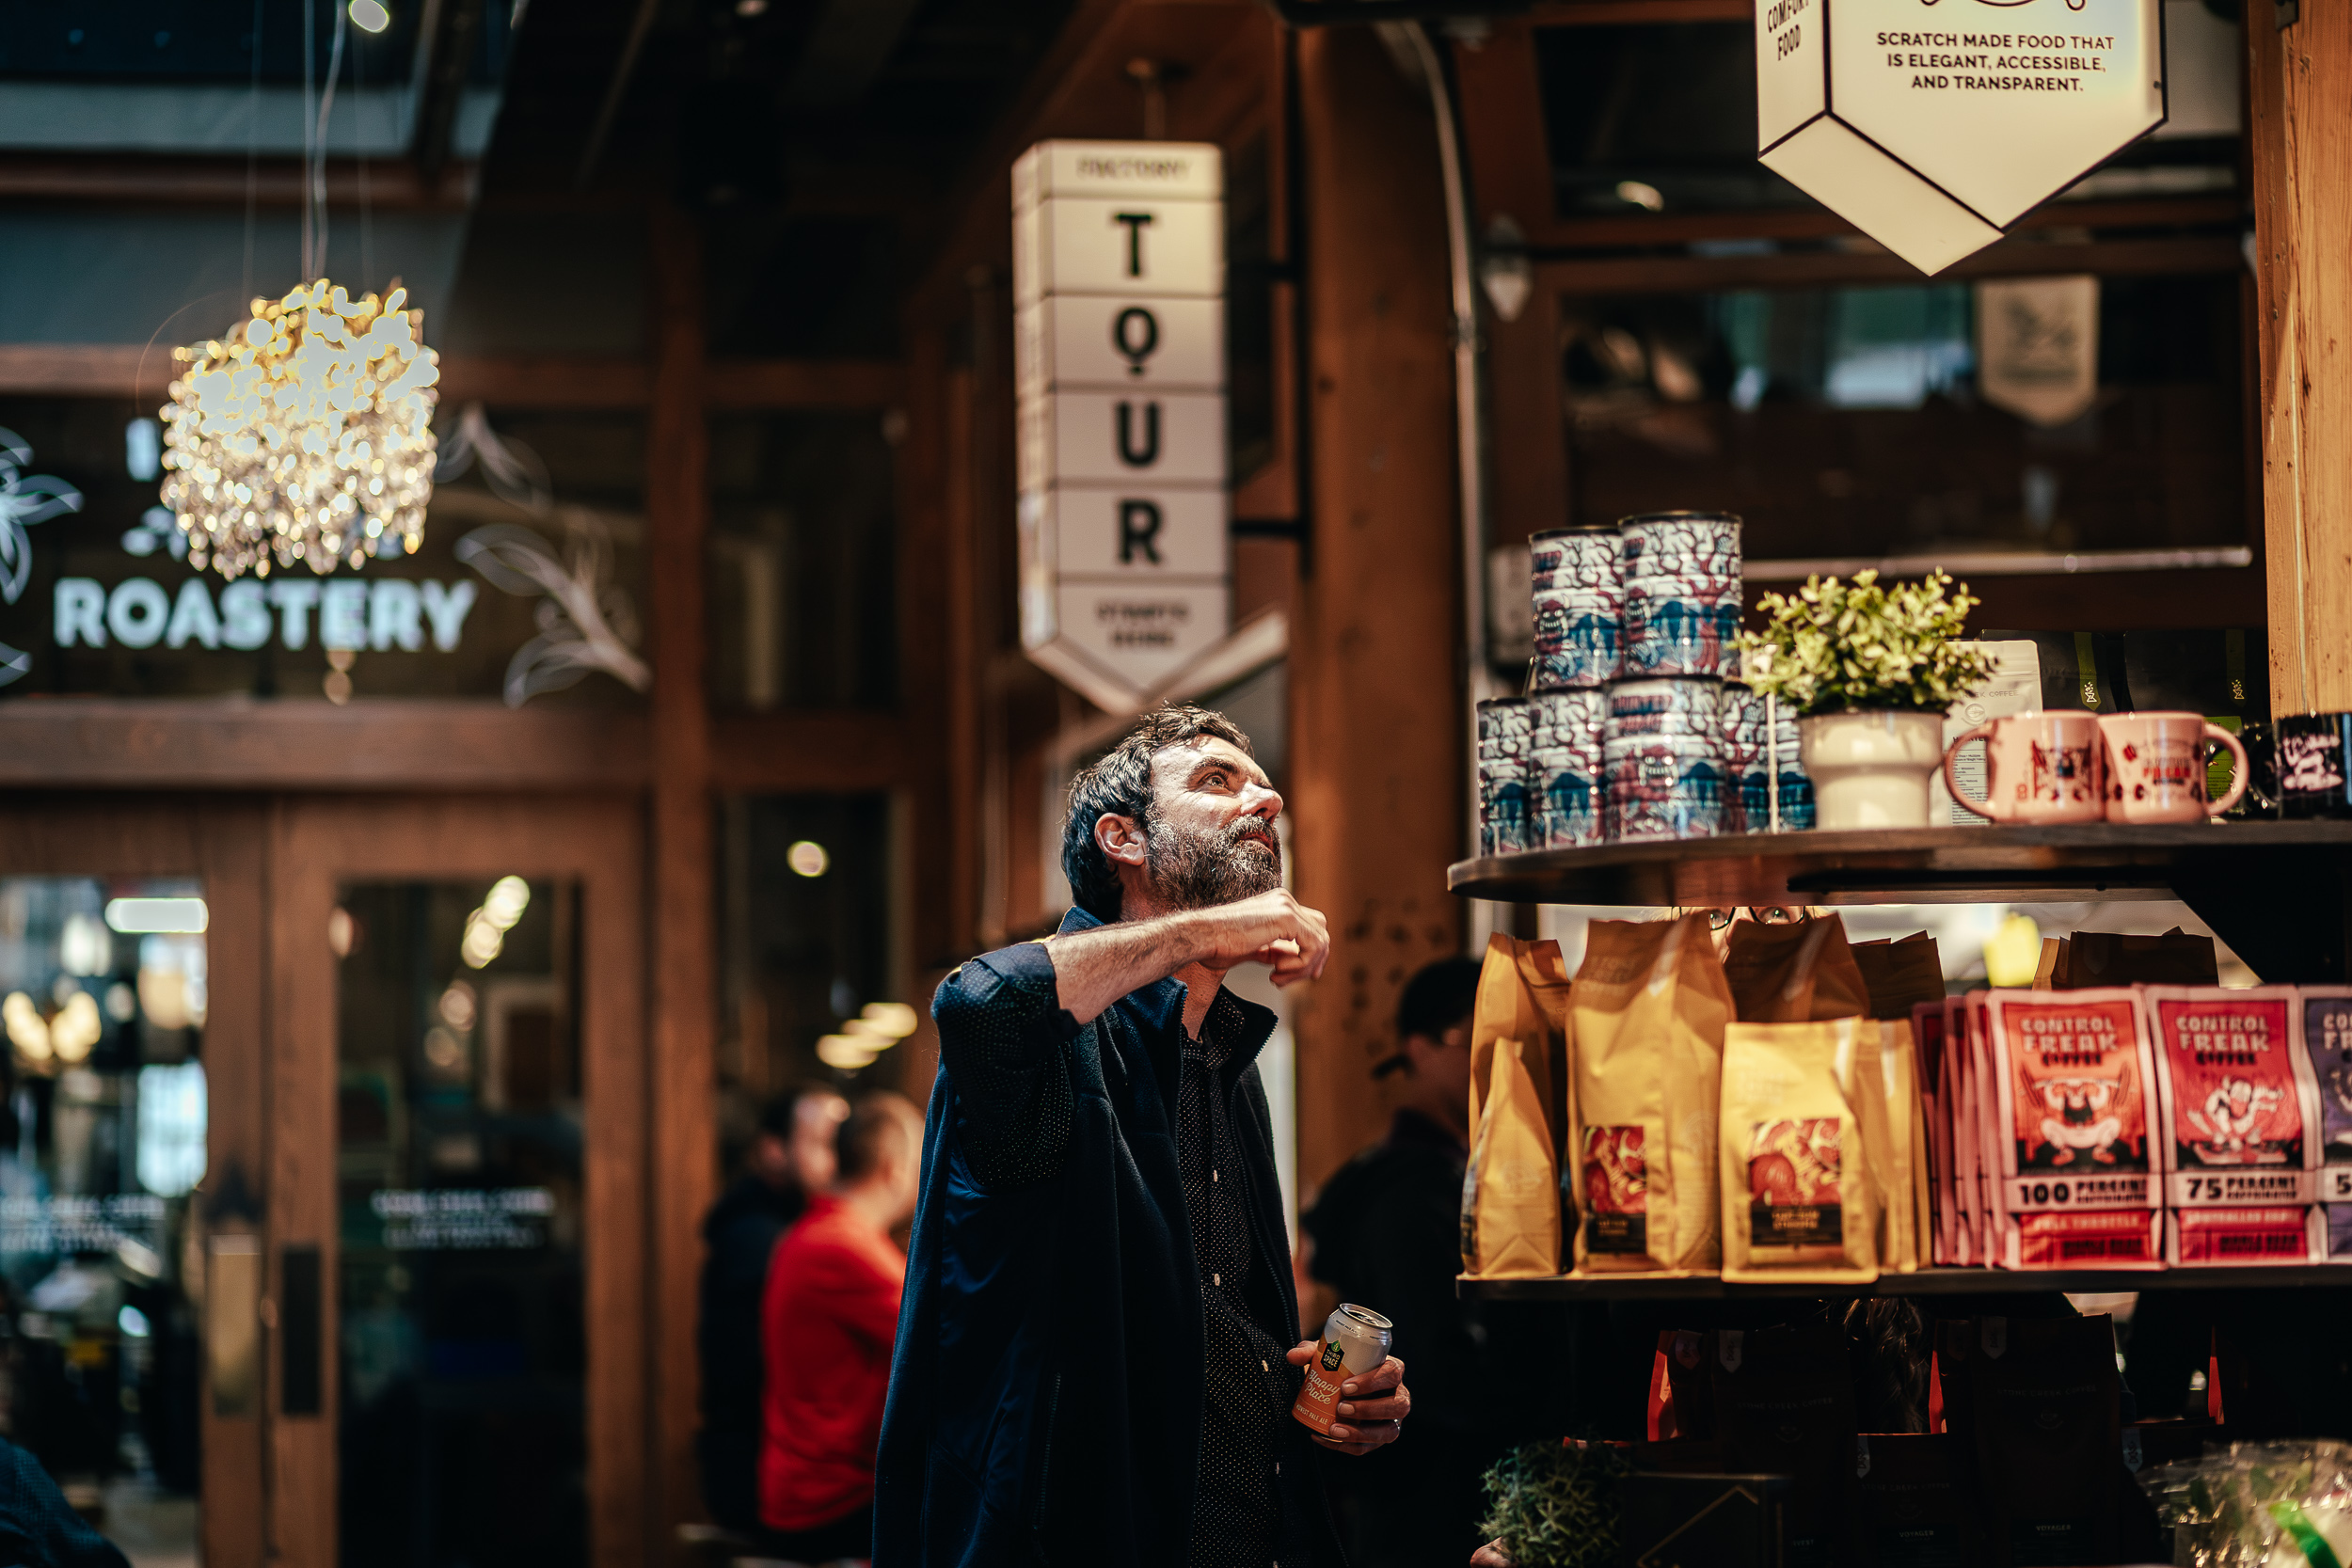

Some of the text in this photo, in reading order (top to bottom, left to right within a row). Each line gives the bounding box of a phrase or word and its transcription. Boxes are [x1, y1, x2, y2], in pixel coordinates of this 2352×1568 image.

[1768, 0, 1808, 33] COMFO
[1778, 24, 1801, 61] FOOD
[1877, 32, 2115, 50] SCRATCH MADE FOOD THAT
[1888, 54, 2106, 72] IS ELEGANT, ACCESSIBLE,
[1912, 75, 2084, 91] AND TRANSPARENT.
[53, 577, 477, 652] ROASTERY
[2020, 1017, 2114, 1034] CONTROL
[2175, 1015, 2268, 1033] CONTROL
[2023, 1034, 2117, 1053] FREAK
[2178, 1032, 2269, 1052] FREAK
[2076, 1180, 2146, 1192] PERCENT
[2186, 1178, 2222, 1200] 75
[2227, 1177, 2296, 1190] PERCENT
[2020, 1181, 2069, 1205] 100
[1323, 1354, 1338, 1367] SPACE
[1327, 1349, 1341, 1360] THIRD
[1309, 1369, 1341, 1396] Happy
[1305, 1382, 1331, 1404] Place
[1309, 1412, 1319, 1421] PALE
[1899, 1529, 1935, 1538] VOYAGER
[2035, 1524, 2072, 1532] VOYAGER
